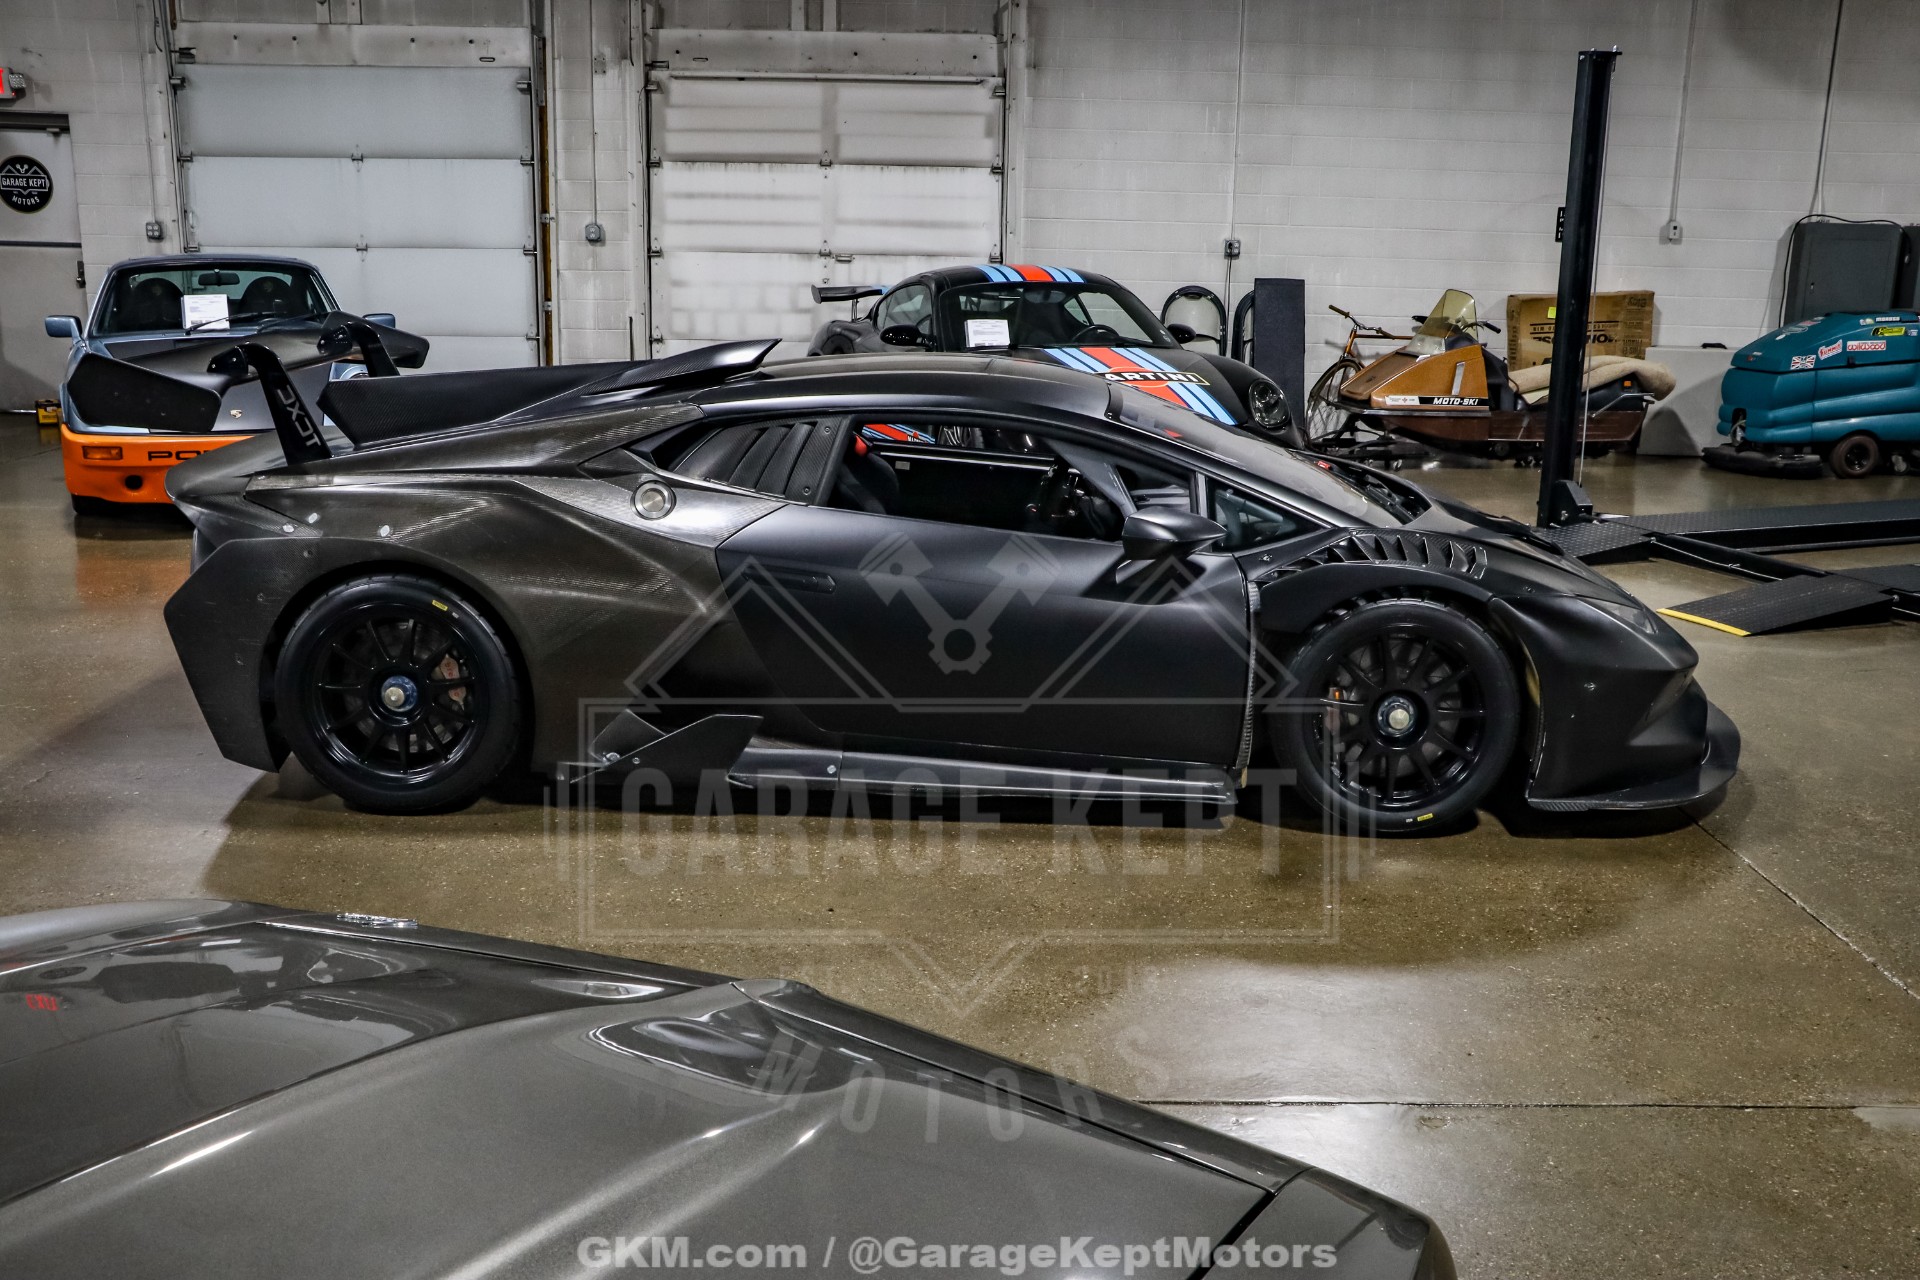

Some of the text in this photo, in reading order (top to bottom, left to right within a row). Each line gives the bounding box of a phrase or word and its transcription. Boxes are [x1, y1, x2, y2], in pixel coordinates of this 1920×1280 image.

[2, 177, 45, 187] GARAGE KEPT
[12, 195, 40, 205] MOTORS
[1104, 372, 1199, 383] ARTINI
[1433, 397, 1479, 406] MOTO-SKI
